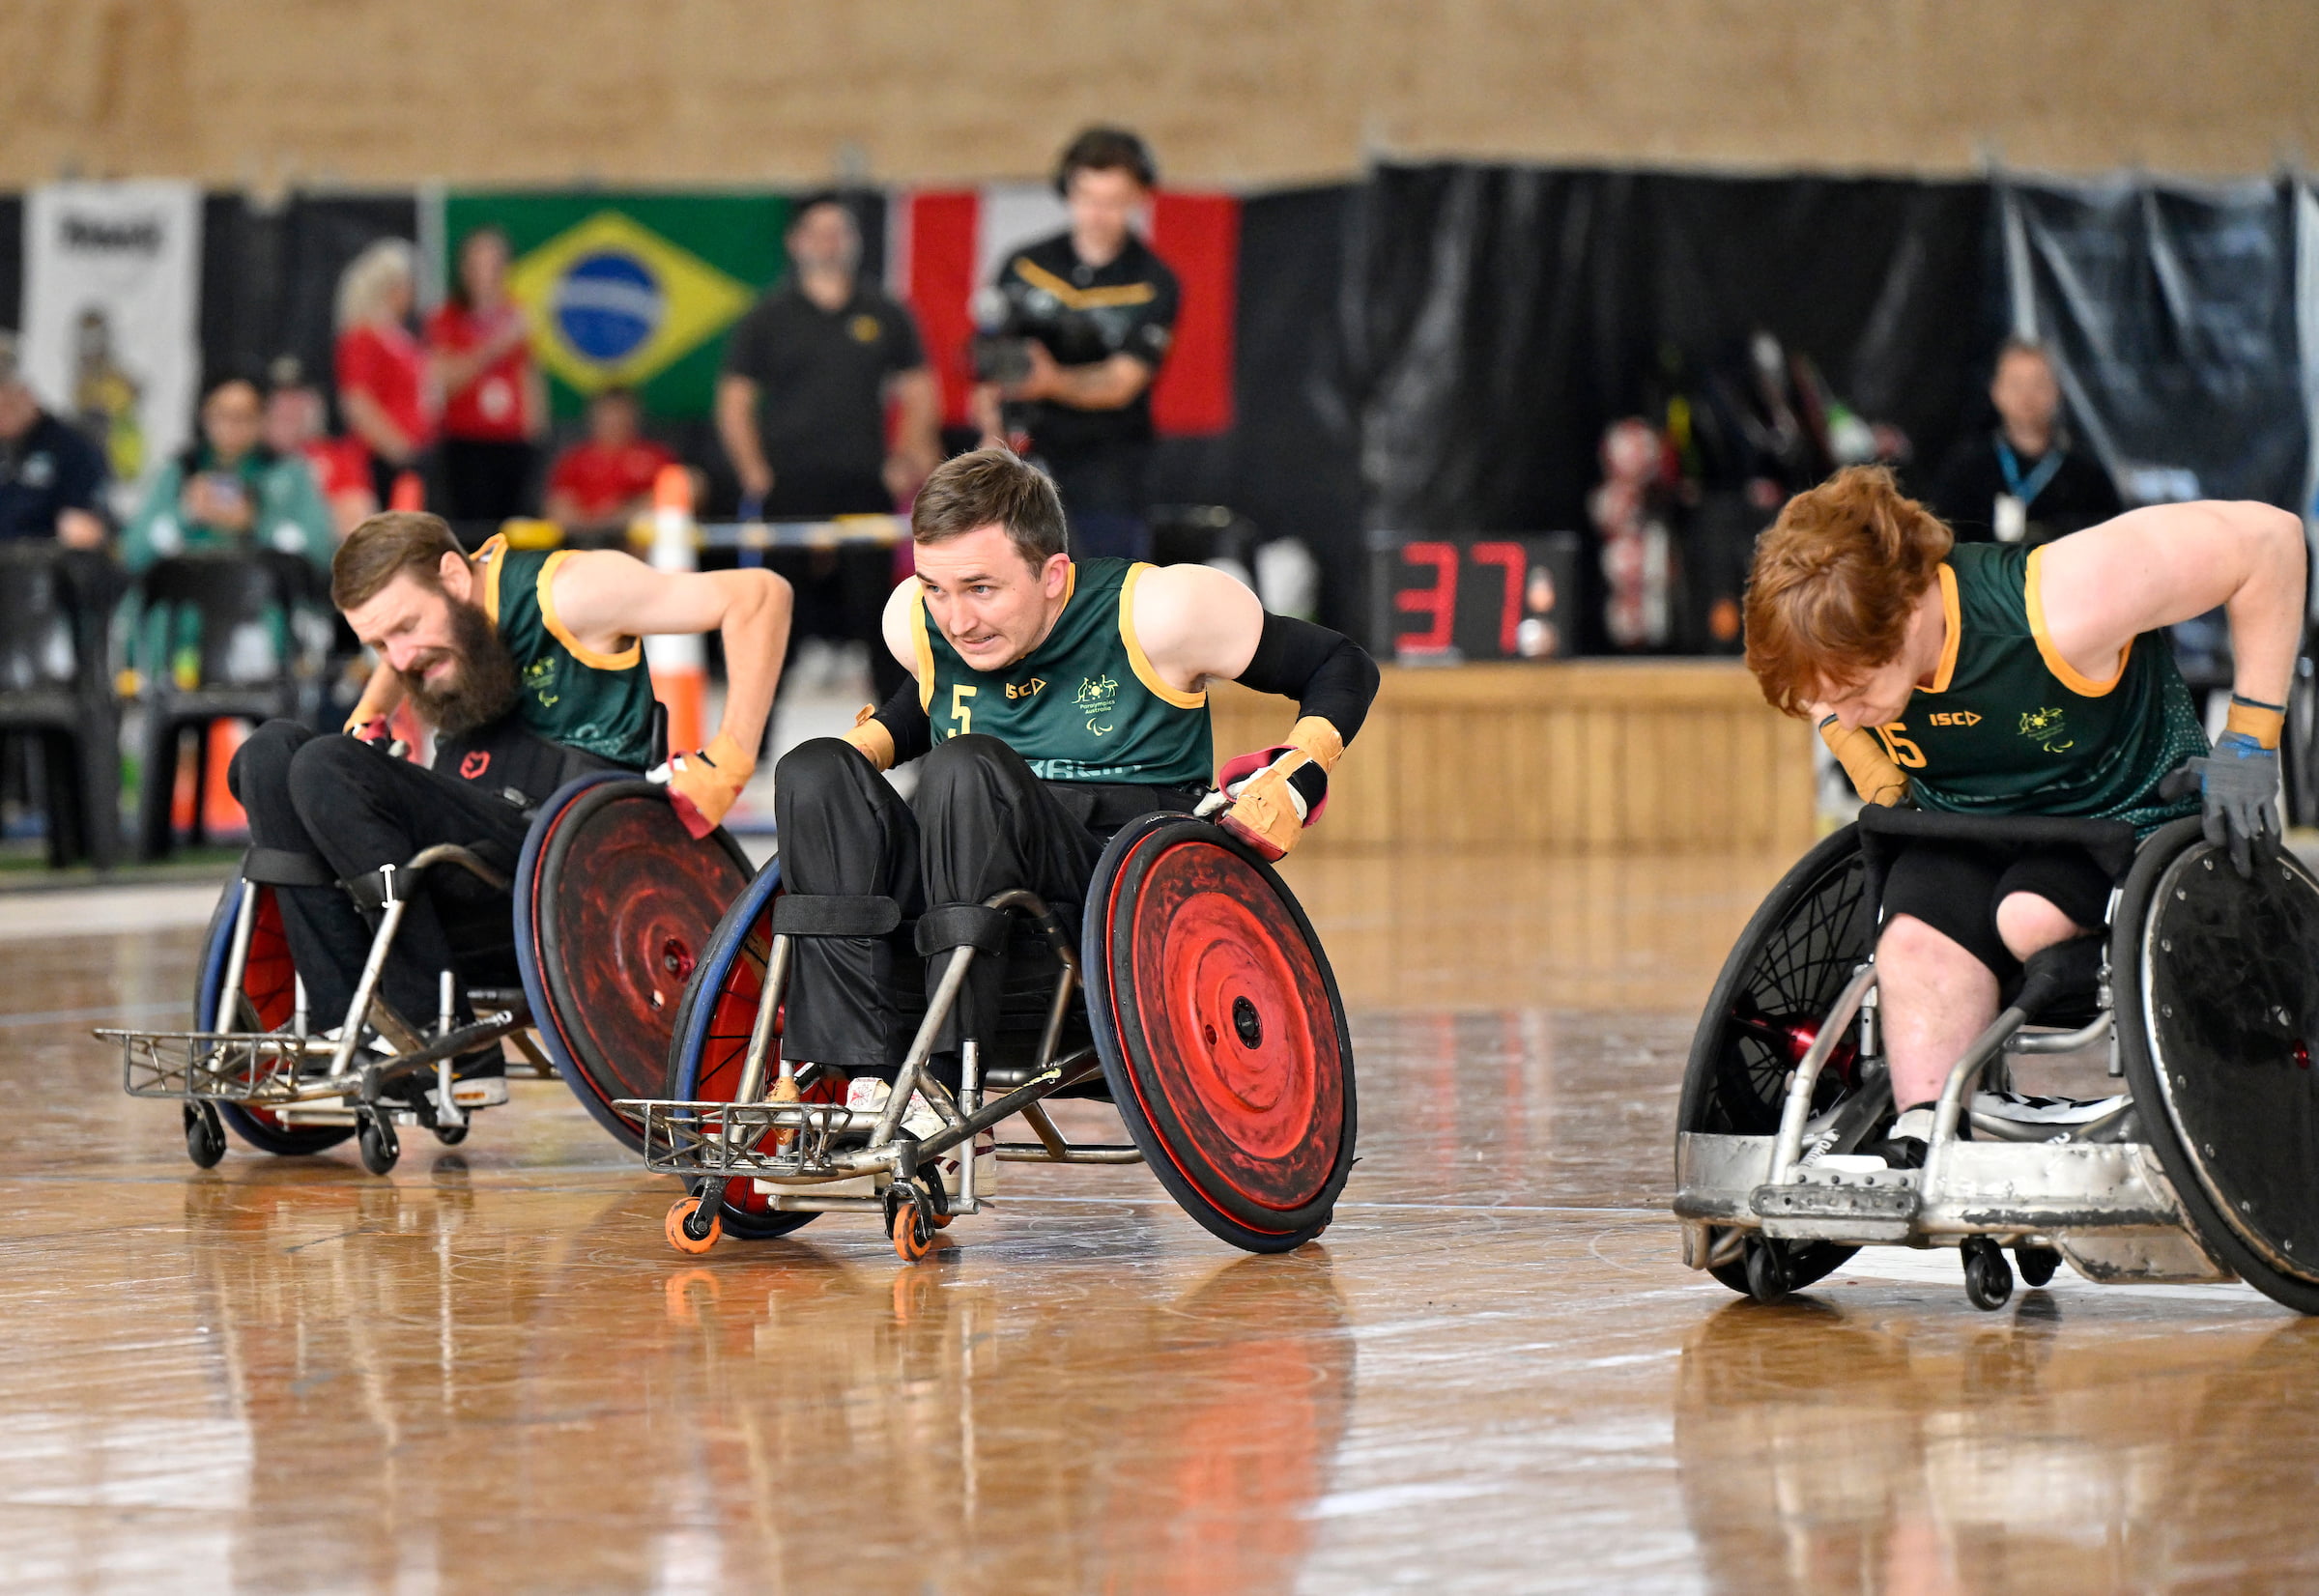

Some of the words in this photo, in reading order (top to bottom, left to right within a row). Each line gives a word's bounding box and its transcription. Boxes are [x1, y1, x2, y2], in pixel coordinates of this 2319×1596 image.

[1394, 541, 1527, 654] 37
[947, 684, 978, 739] 5
[1079, 699, 1116, 710] Paralympics
[1084, 706, 1112, 715] Australia
